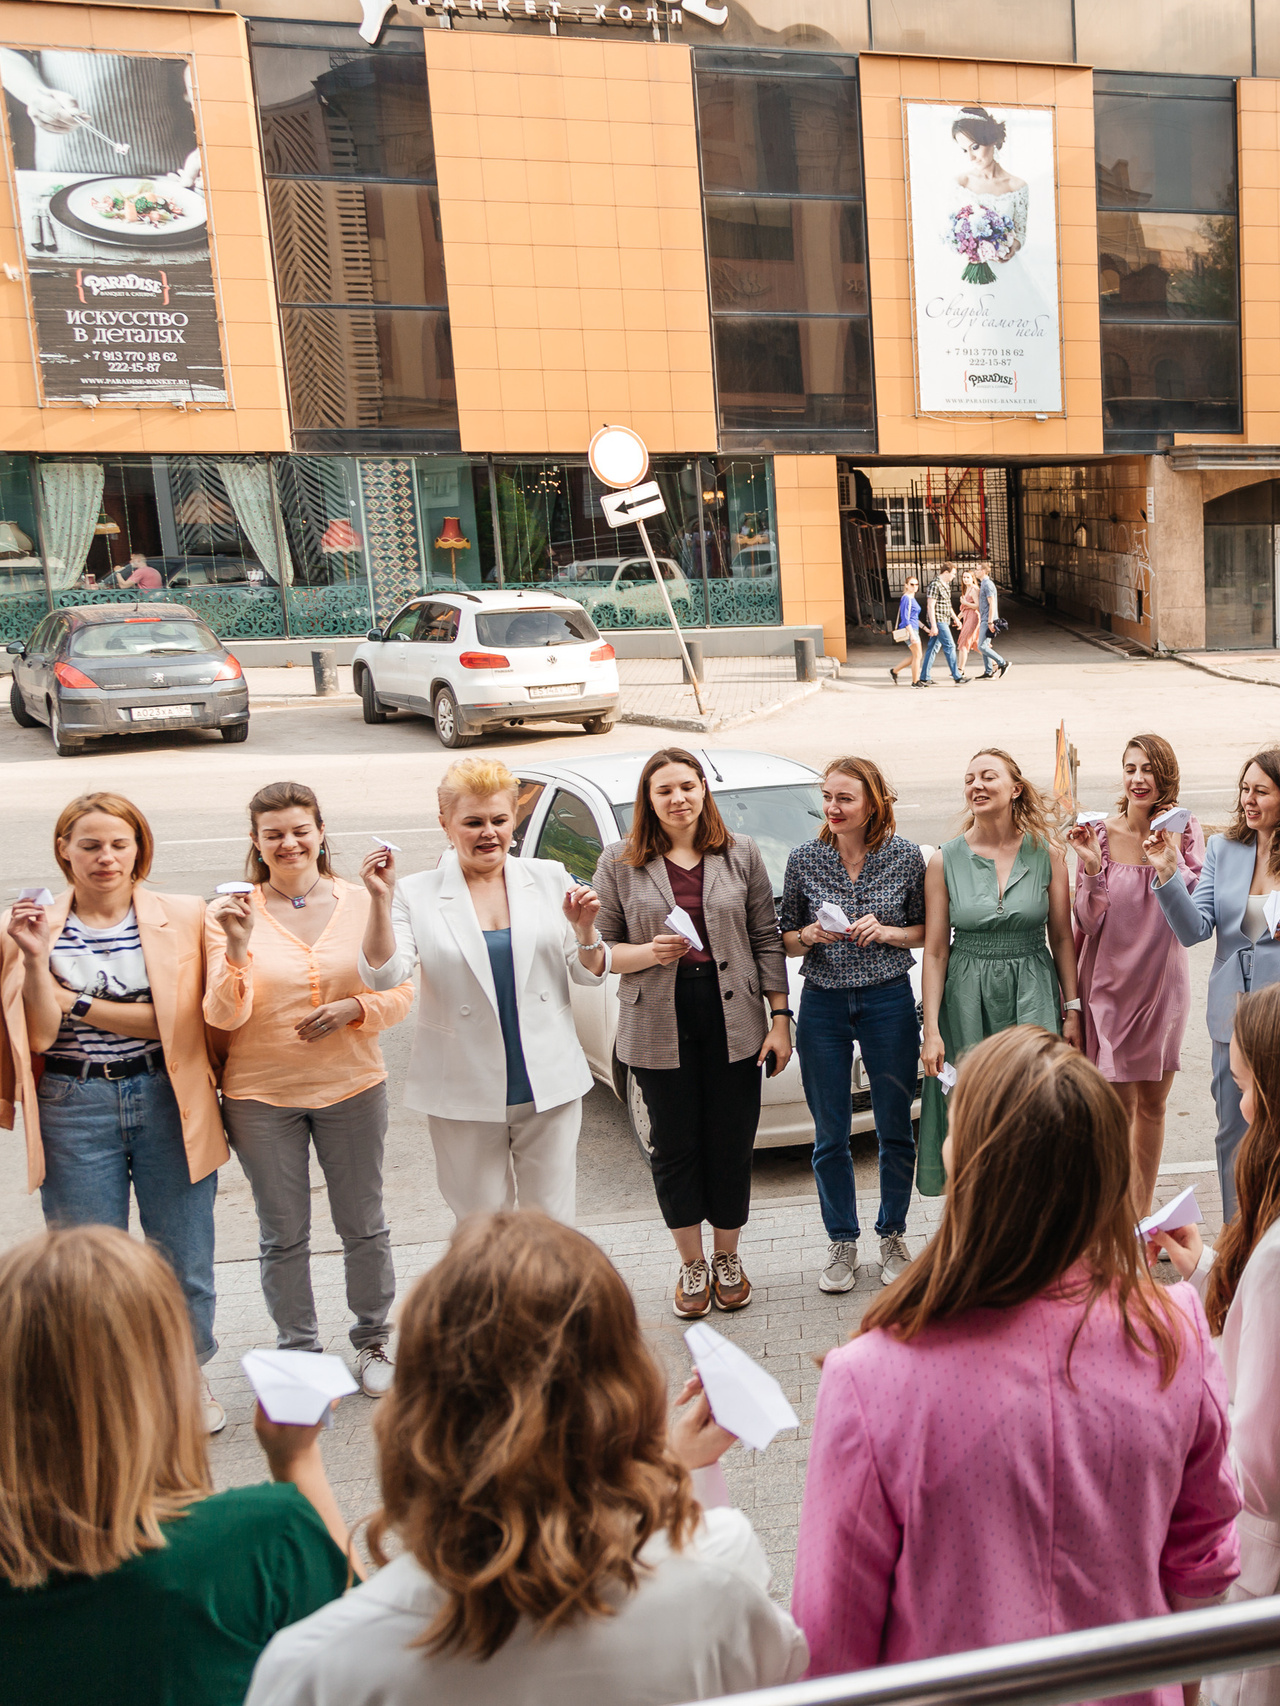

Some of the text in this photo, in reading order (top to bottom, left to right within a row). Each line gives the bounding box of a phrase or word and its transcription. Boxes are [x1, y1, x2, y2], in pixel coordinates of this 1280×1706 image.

[925, 293, 995, 328] Свадьба
[65, 310, 189, 327] ИСКУССТВО
[981, 318, 1029, 328] самого
[1015, 314, 1050, 337] неба
[92, 350, 101, 360] 7
[102, 351, 123, 361] 913
[123, 351, 146, 361] 770
[147, 351, 161, 361] 18
[162, 352, 178, 362] 62
[962, 348, 979, 356] 913
[981, 348, 998, 356] 770
[1000, 348, 1011, 356] 18
[1013, 348, 1024, 357] 62
[107, 362, 161, 373] 222-15-87
[968, 358, 1012, 367] 222-15-87
